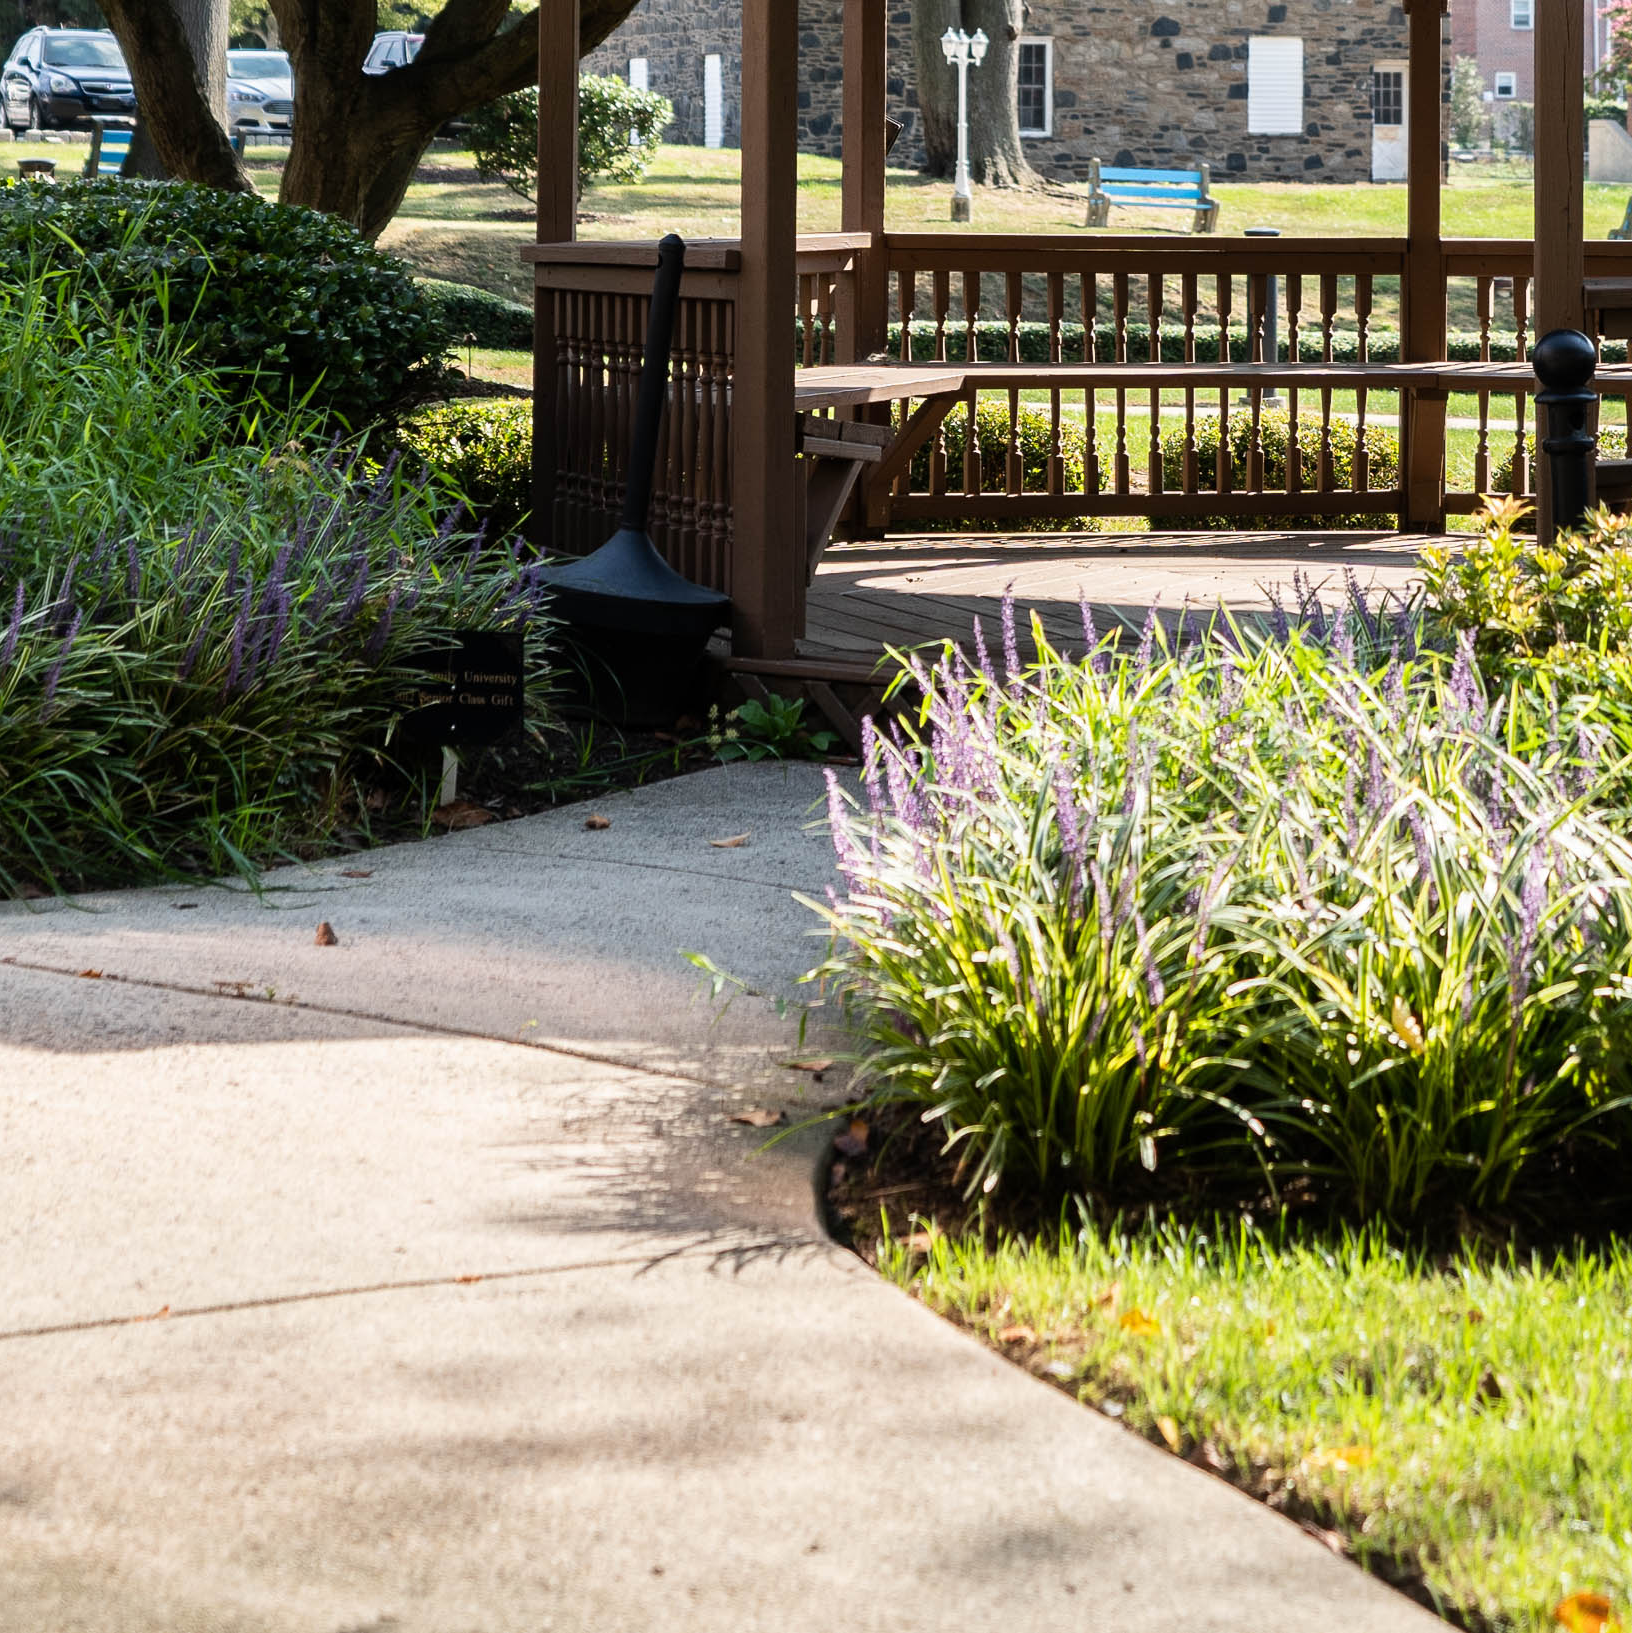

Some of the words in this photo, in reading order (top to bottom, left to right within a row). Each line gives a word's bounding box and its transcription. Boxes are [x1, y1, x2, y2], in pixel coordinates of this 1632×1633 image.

[464, 671, 517, 685] University
[419, 693, 453, 705] Senior
[459, 693, 486, 705] Class
[491, 694, 514, 706] Gift
